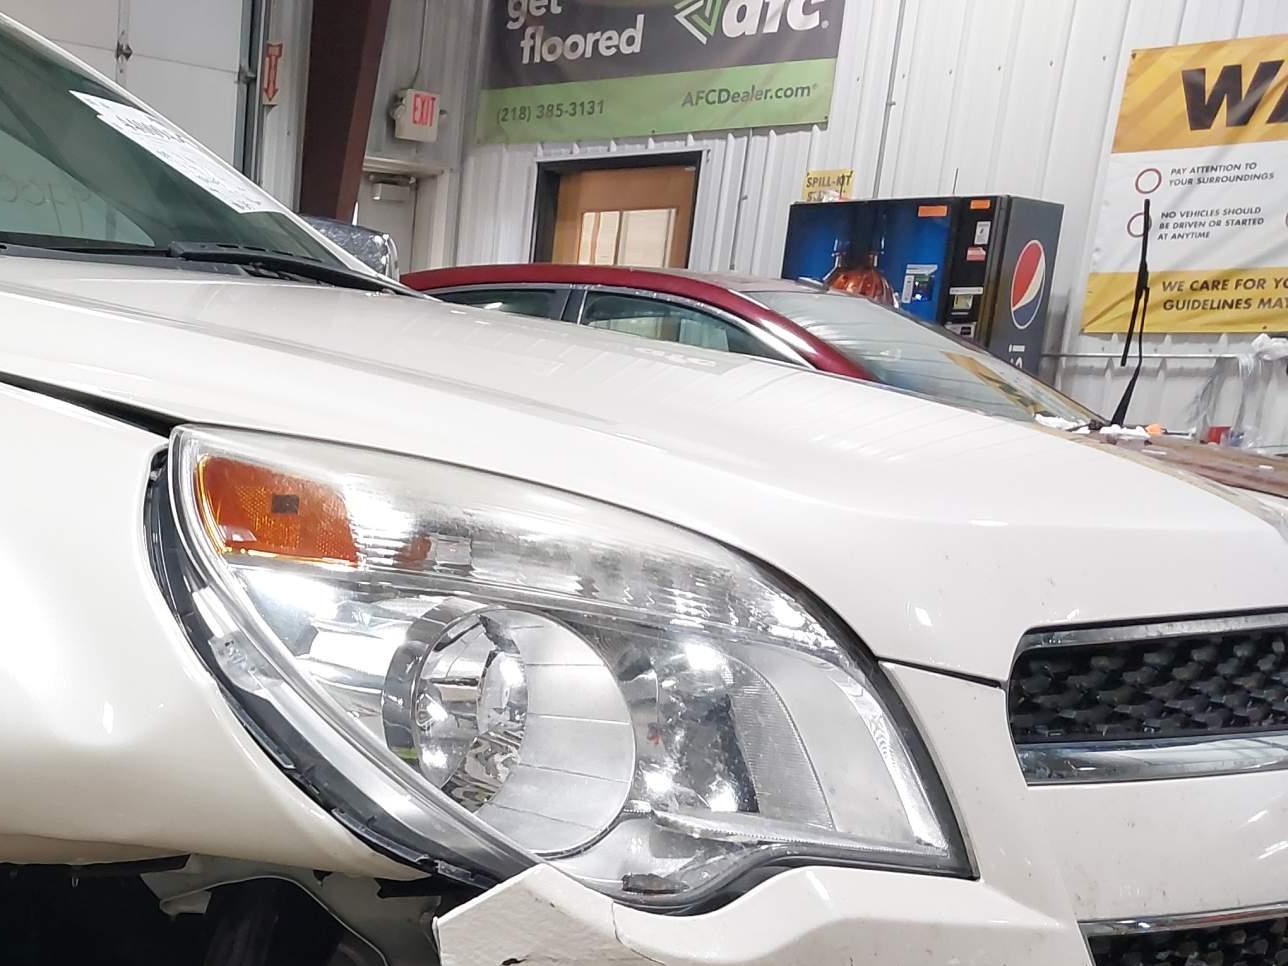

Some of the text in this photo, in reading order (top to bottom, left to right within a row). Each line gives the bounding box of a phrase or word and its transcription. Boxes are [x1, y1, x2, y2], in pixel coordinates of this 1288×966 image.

[520, 13, 645, 65] floored
[412, 94, 436, 127] EXIT
[496, 100, 604, 125] (218) 385-3131
[1170, 162, 1257, 175] PAY ATTENTION TO
[1196, 172, 1275, 185] SURROUNDINGS
[1161, 206, 1262, 219] NO VEHICLES SHOULD
[1159, 217, 1265, 230] BE DRIVEN OR STARTED
[1171, 231, 1211, 240] ANYTIME
[1162, 281, 1185, 292] WE
[1189, 279, 1231, 291] CARE
[1234, 278, 1267, 290] FOR
[1163, 298, 1252, 311] GUIDELINES
